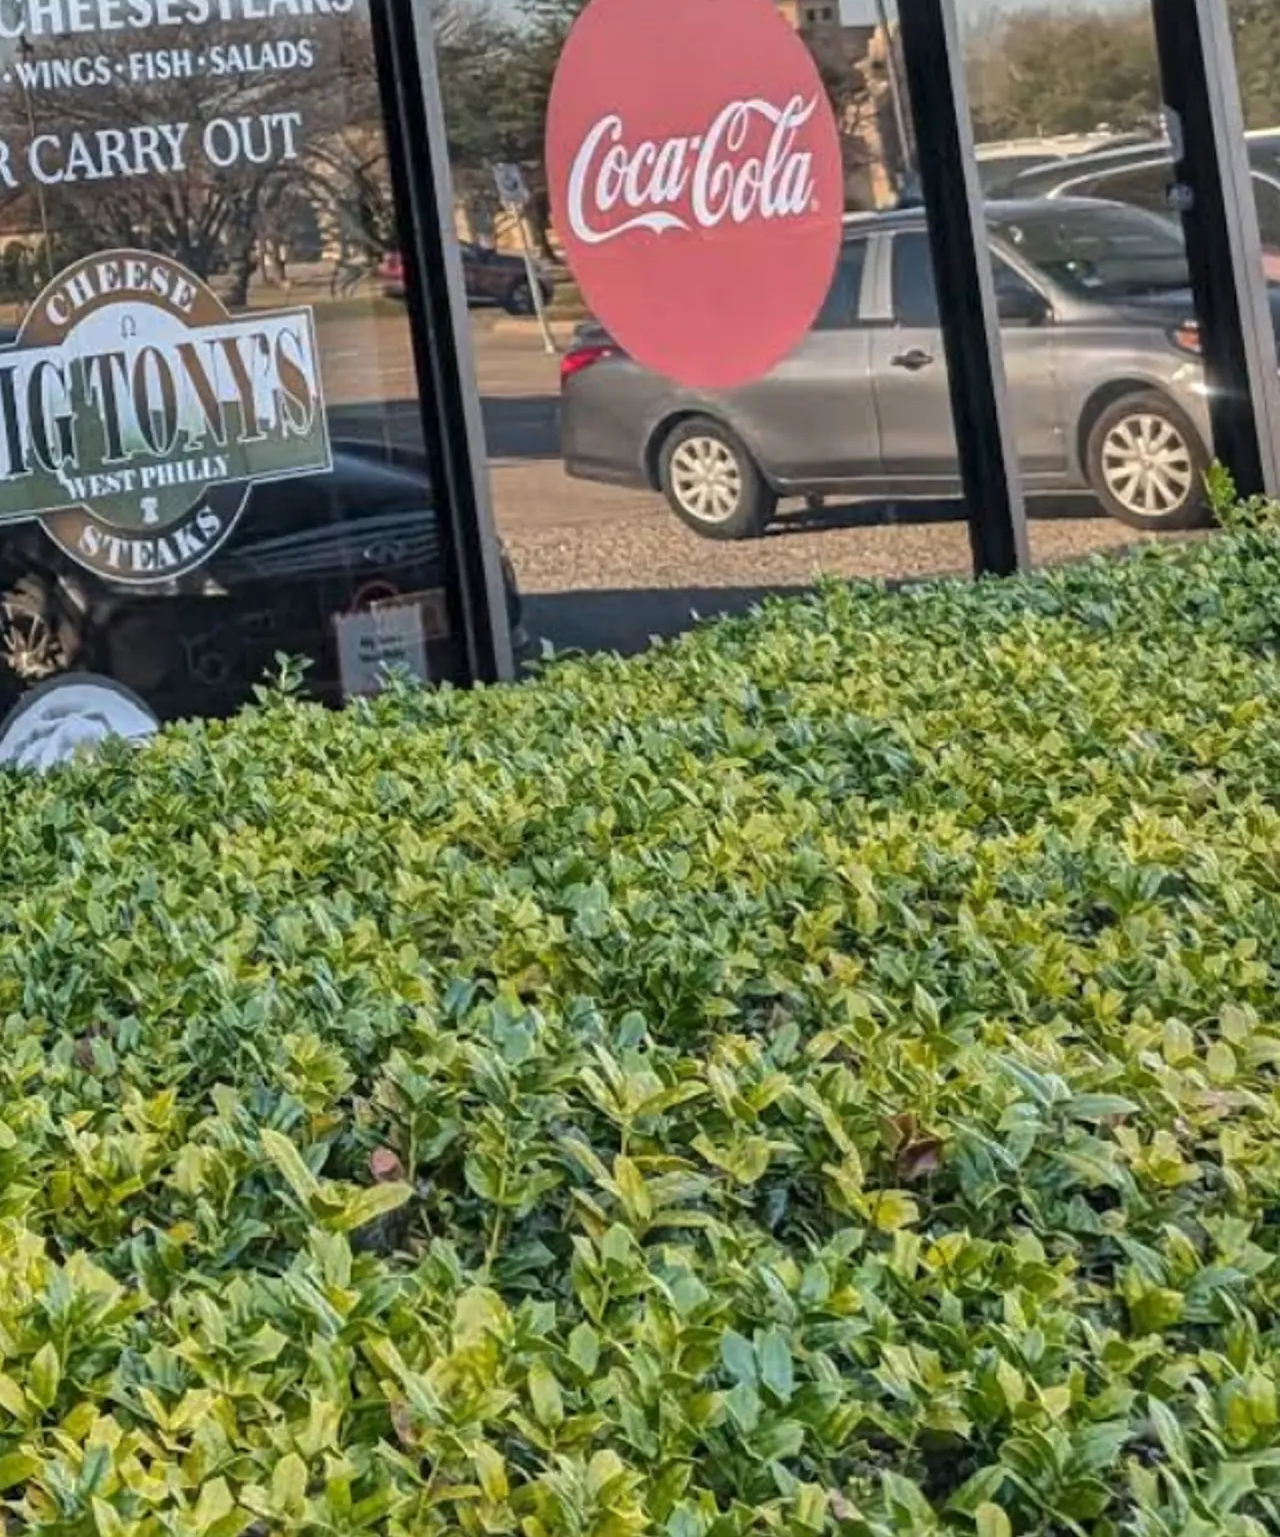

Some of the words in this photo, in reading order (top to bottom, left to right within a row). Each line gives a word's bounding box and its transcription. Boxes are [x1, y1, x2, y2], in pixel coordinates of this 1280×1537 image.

[14, 55, 111, 93] WINGS
[130, 49, 193, 81] FISH
[207, 38, 314, 75] SALADS
[28, 121, 190, 185] CARRY
[203, 112, 302, 165] OUT
[567, 93, 820, 243] Coca-Cola
[45, 259, 197, 325] CHEESE
[64, 469, 136, 501] WEST
[141, 455, 228, 490] PHILLY
[77, 506, 223, 571] STEAKS
